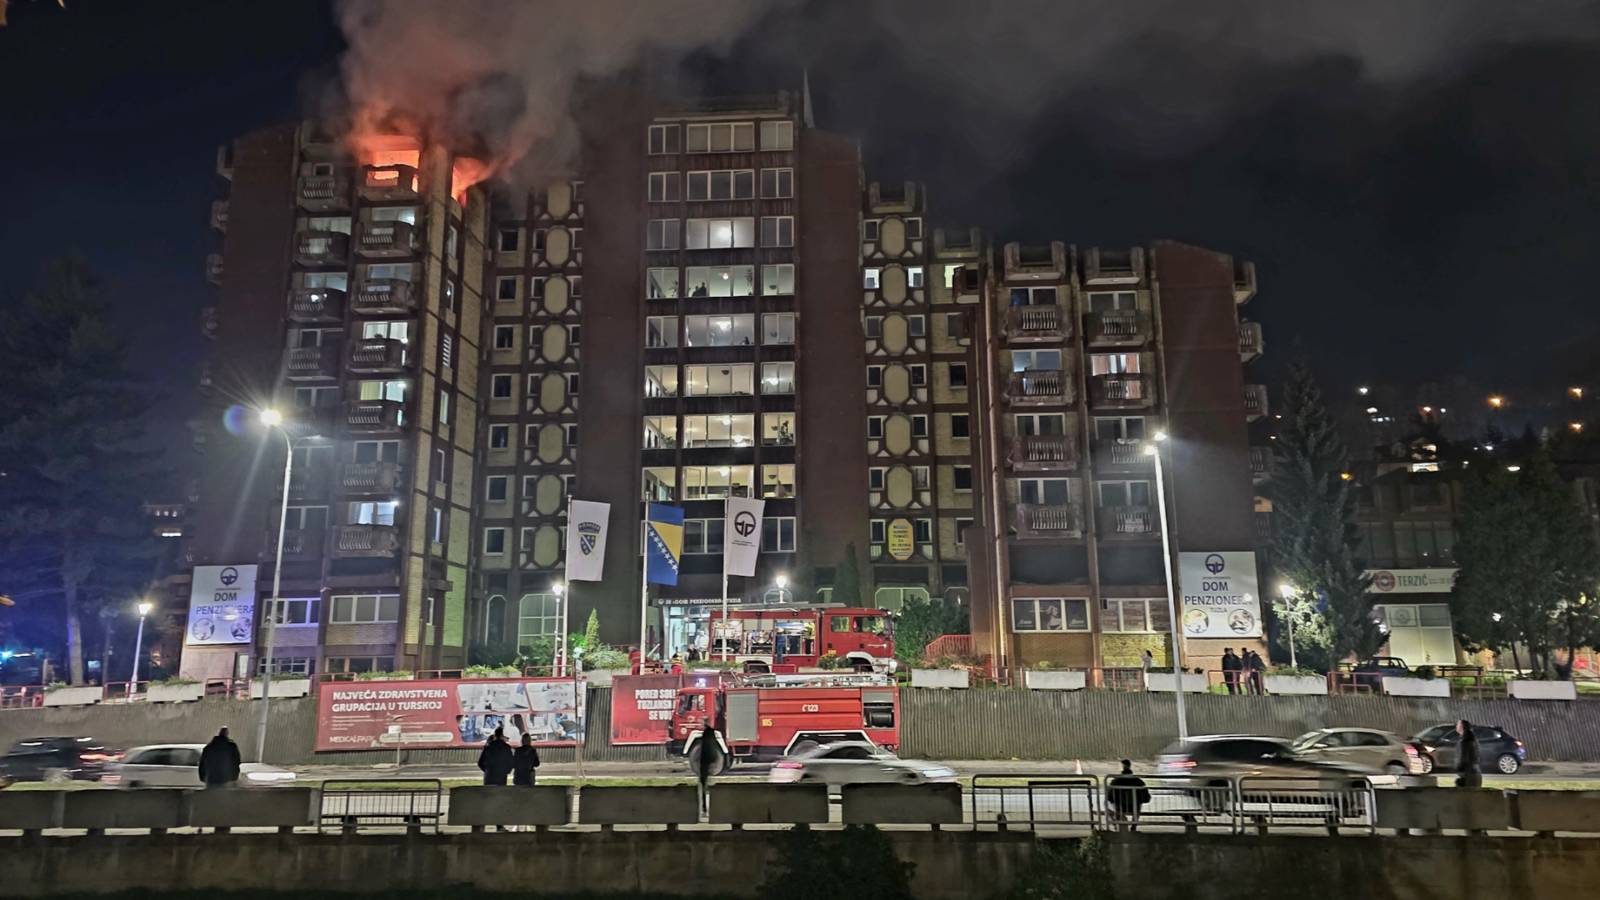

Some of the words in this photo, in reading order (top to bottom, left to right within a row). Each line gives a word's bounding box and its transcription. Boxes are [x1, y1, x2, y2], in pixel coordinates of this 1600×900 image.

[1202, 581, 1229, 592] DOM
[214, 592, 237, 602] DOM
[333, 689, 377, 700] NAJVEĆA
[378, 689, 448, 699] ZDRAVSTVENA
[332, 702, 387, 712] GRUPACIJA
[388, 702, 396, 710] U
[398, 701, 442, 710] TURSKOJ
